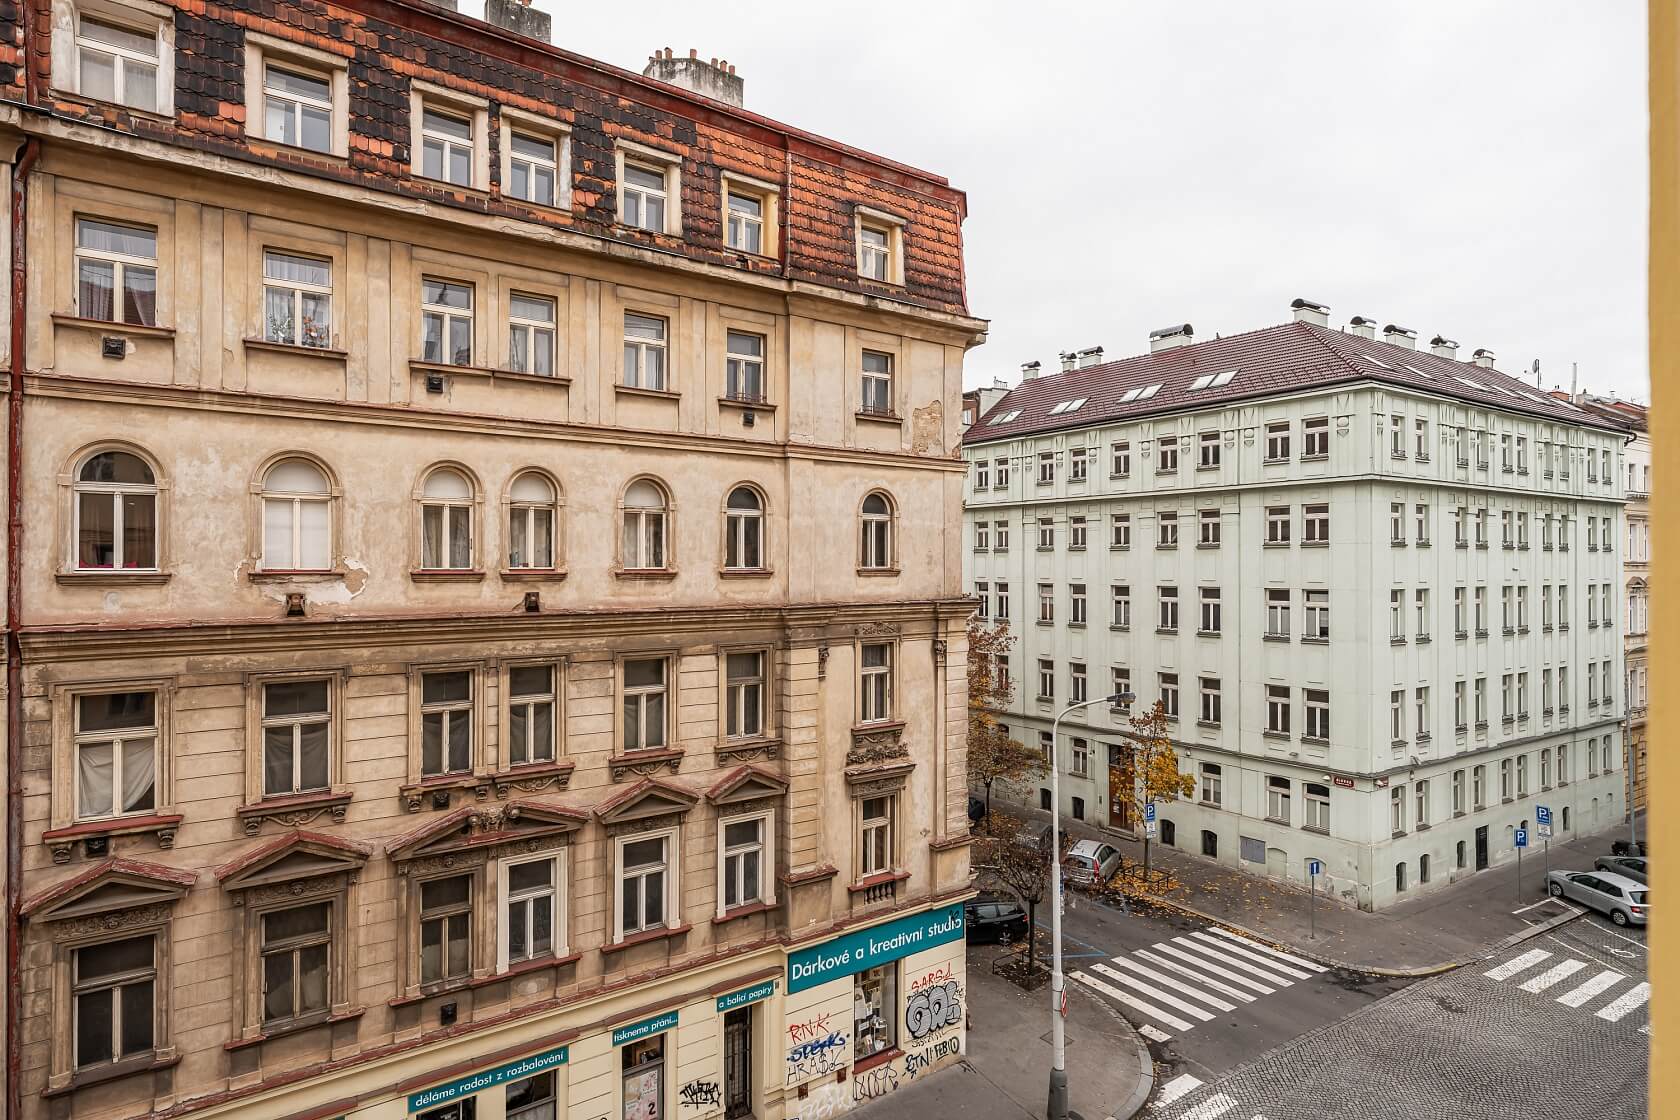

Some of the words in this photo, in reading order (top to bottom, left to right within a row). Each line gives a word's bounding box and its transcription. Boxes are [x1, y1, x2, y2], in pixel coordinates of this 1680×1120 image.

[1147, 805, 1154, 817] P
[1539, 807, 1547, 818] P
[1517, 831, 1525, 842] P
[791, 950, 850, 980] Dárkové
[855, 947, 864, 960] a
[869, 926, 924, 956] kreativní
[928, 915, 962, 938] studio
[727, 993, 746, 1006] balicí
[748, 985, 772, 1000] papíry
[613, 1026, 649, 1043] tiskneme
[415, 1087, 455, 1107] děláme
[459, 1074, 492, 1093] radost
[496, 1072, 502, 1081] z
[506, 1050, 564, 1077] rozbalování
[648, 1102, 656, 1115] 2
